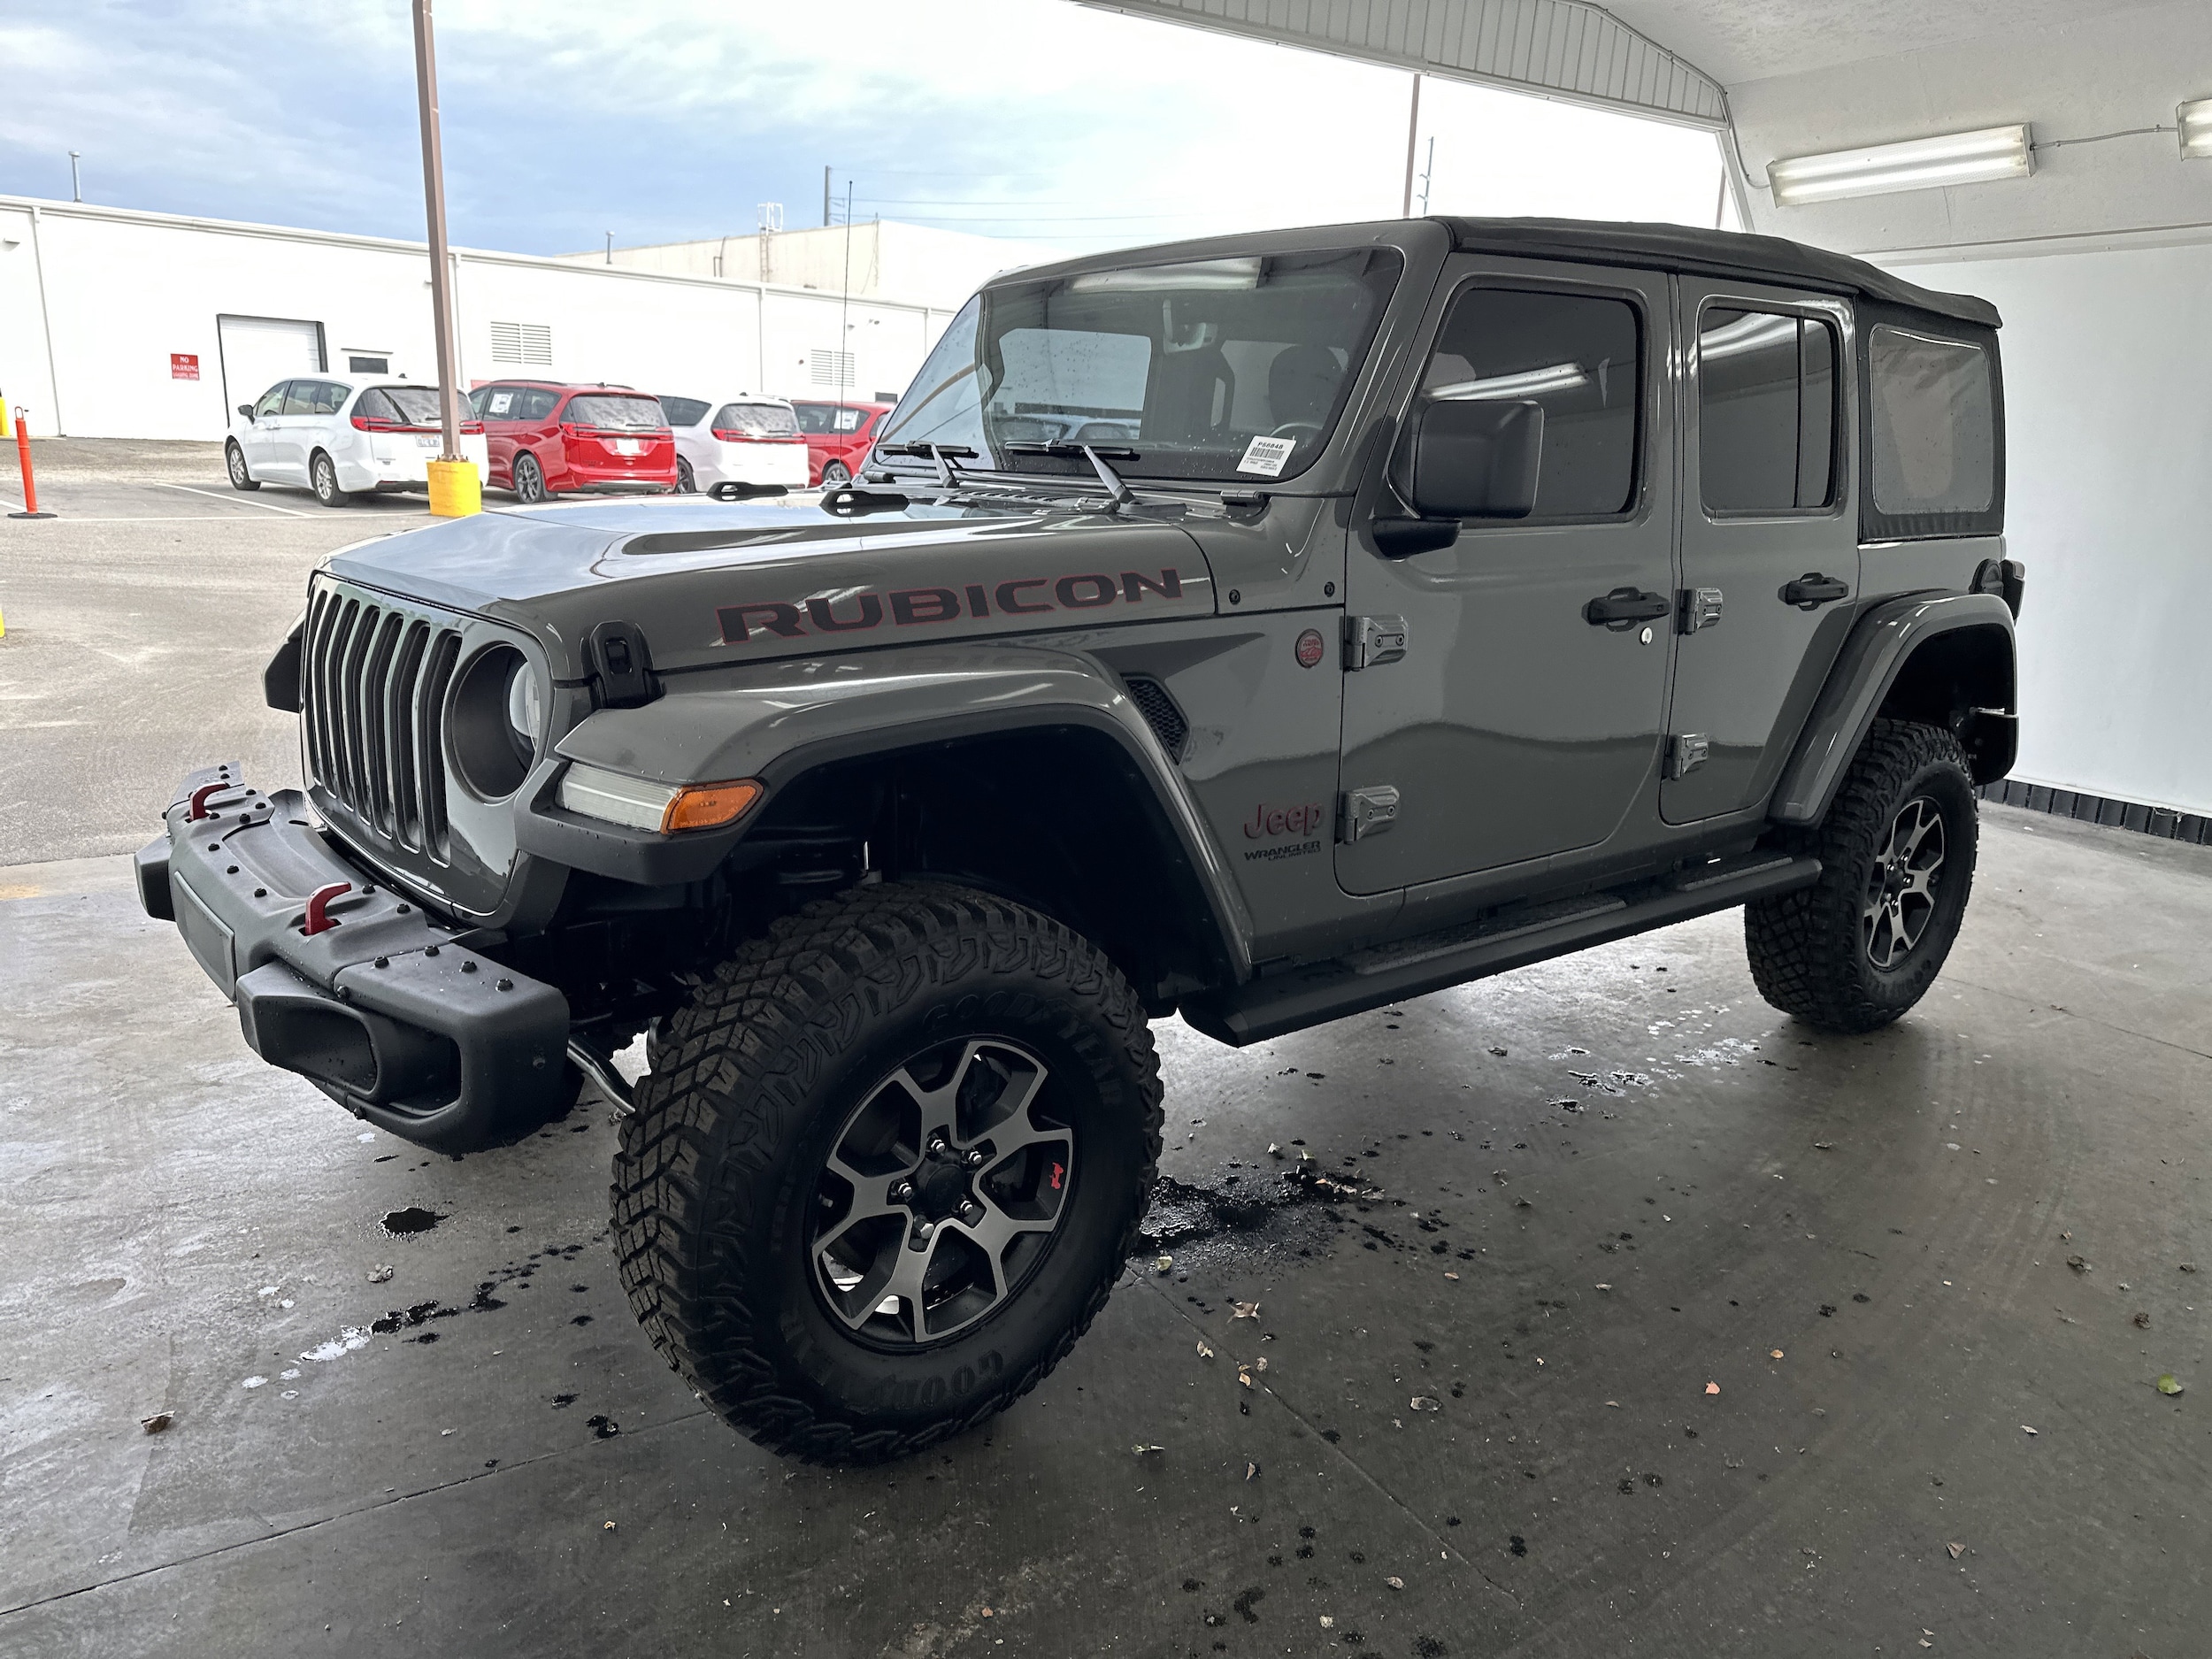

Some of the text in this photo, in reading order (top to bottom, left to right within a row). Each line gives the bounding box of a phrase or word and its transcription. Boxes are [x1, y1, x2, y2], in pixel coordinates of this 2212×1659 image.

[172, 364, 198, 373] PARKING
[714, 567, 1184, 646] RUBICON
[1244, 802, 1324, 839] Jeep
[1243, 840, 1322, 861] WRANGLER
[1268, 846, 1322, 862] UNLIMITED
